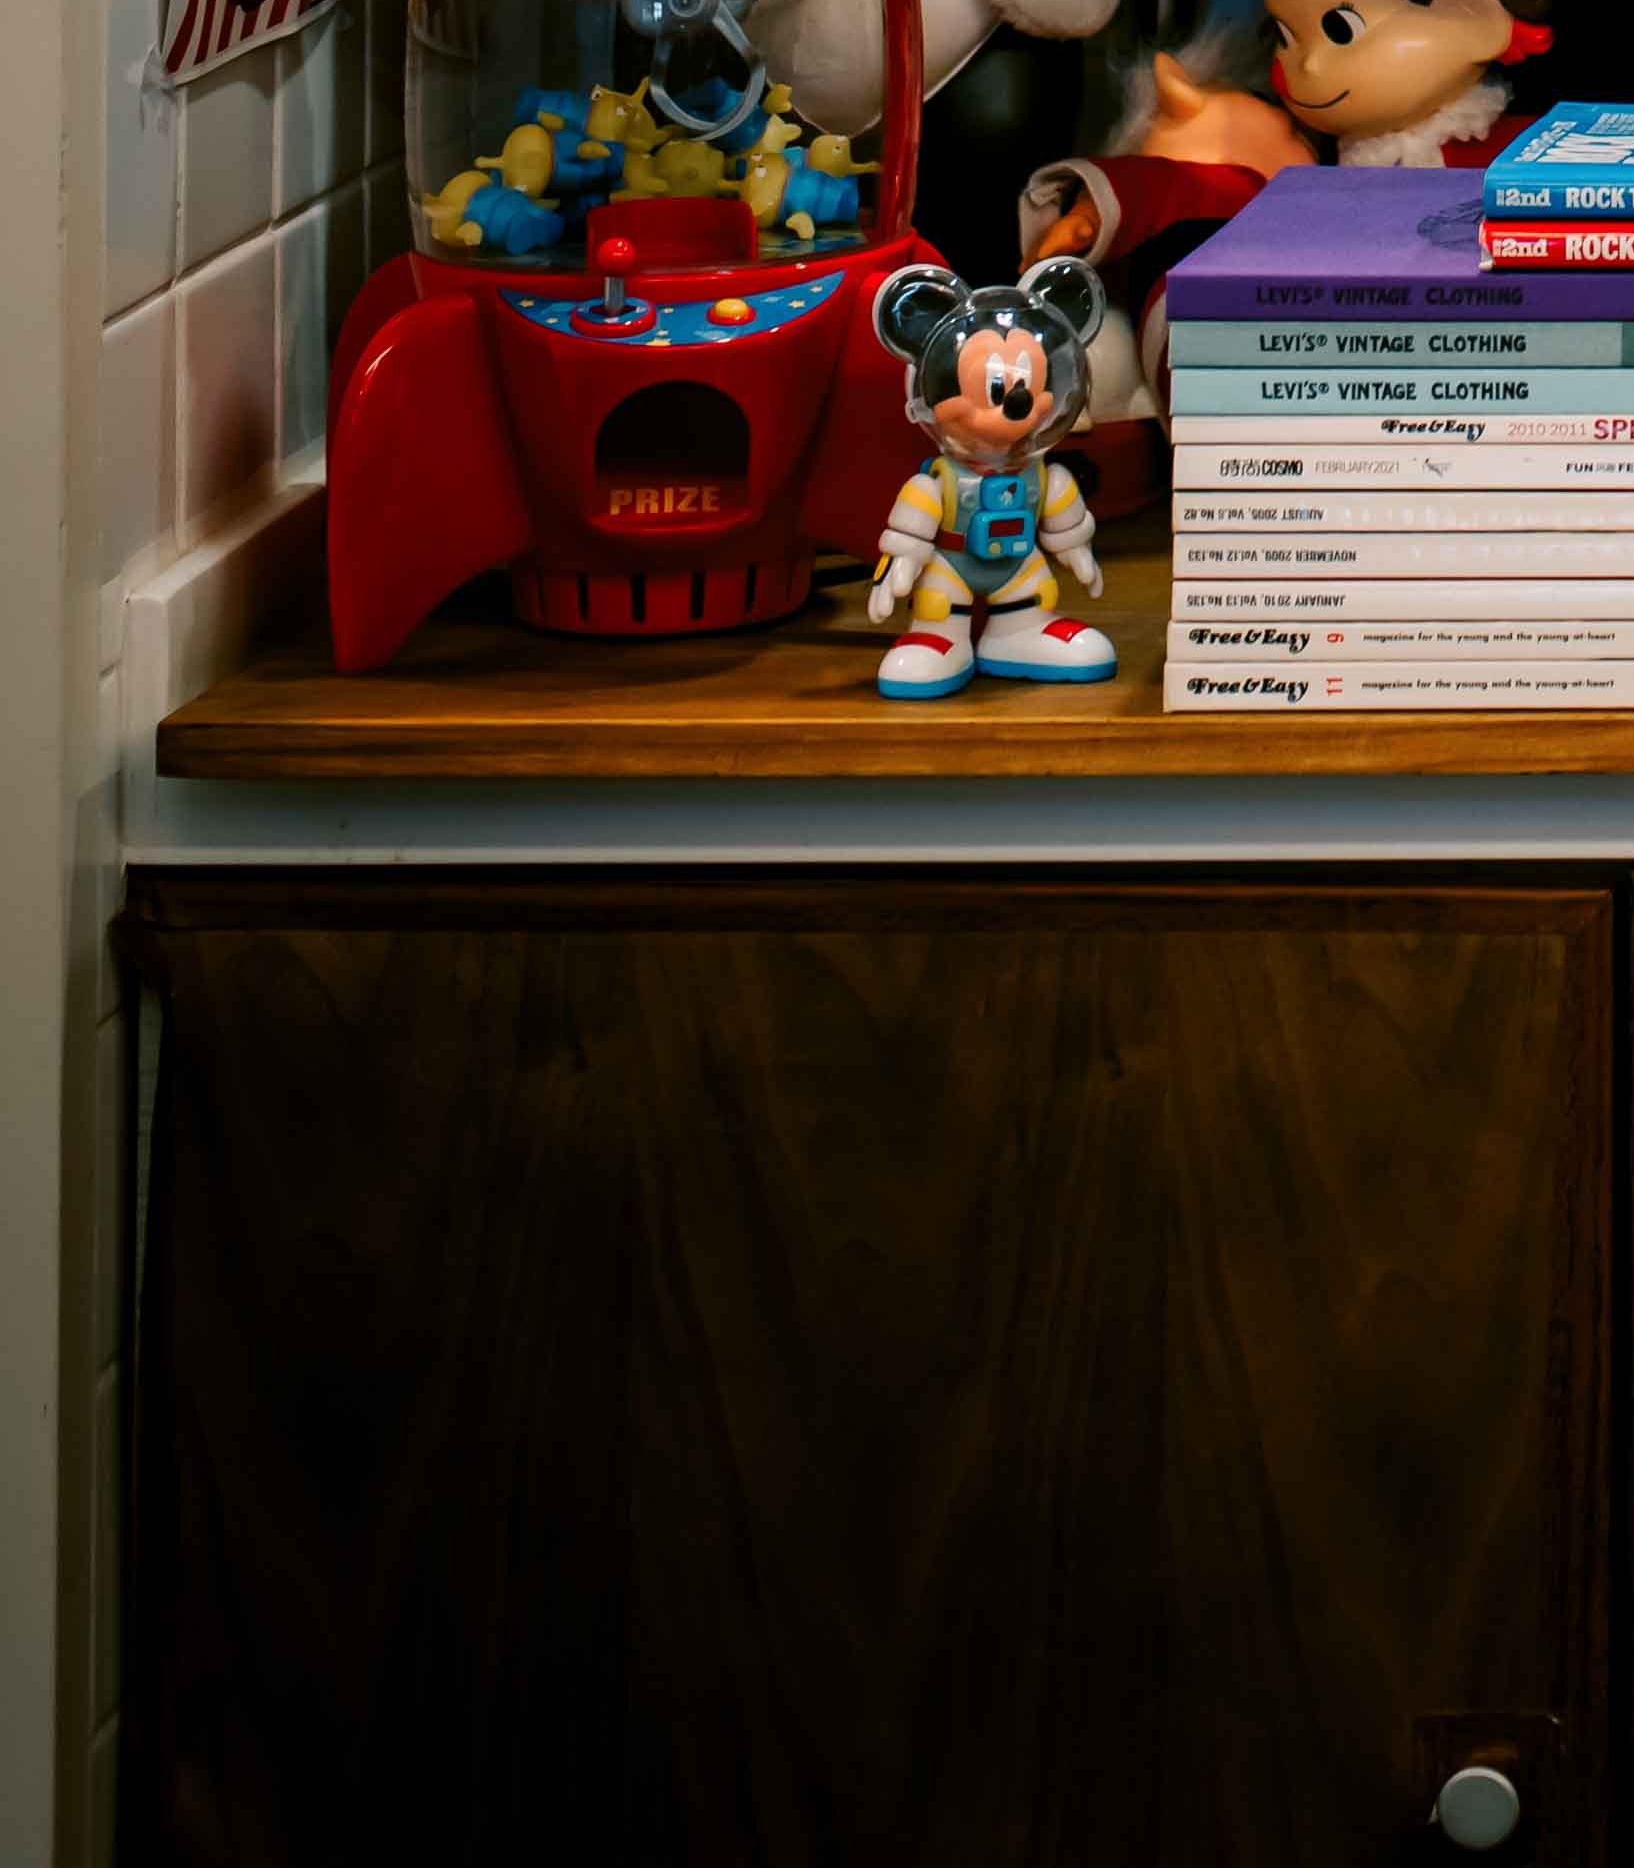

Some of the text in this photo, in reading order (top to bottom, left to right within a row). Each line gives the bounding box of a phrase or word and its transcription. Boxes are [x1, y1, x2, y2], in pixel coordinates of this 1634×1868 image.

[1565, 187, 1626, 209] ROCK
[1333, 286, 1410, 306] VINTAGE
[1426, 286, 1524, 306] CLOTHING
[1336, 334, 1415, 354] VINTAGE
[1428, 334, 1527, 354] CLOTHING
[1338, 382, 1417, 401] VINTAGE
[1431, 381, 1529, 401] CLOTHING
[1507, 422, 1546, 437] 2010
[1549, 422, 1588, 437] 2011
[1565, 462, 1594, 474] FUN
[609, 485, 721, 516] PRIZE
[1295, 550, 1357, 562] NOVEMBER
[1294, 595, 1346, 607] JANUARY
